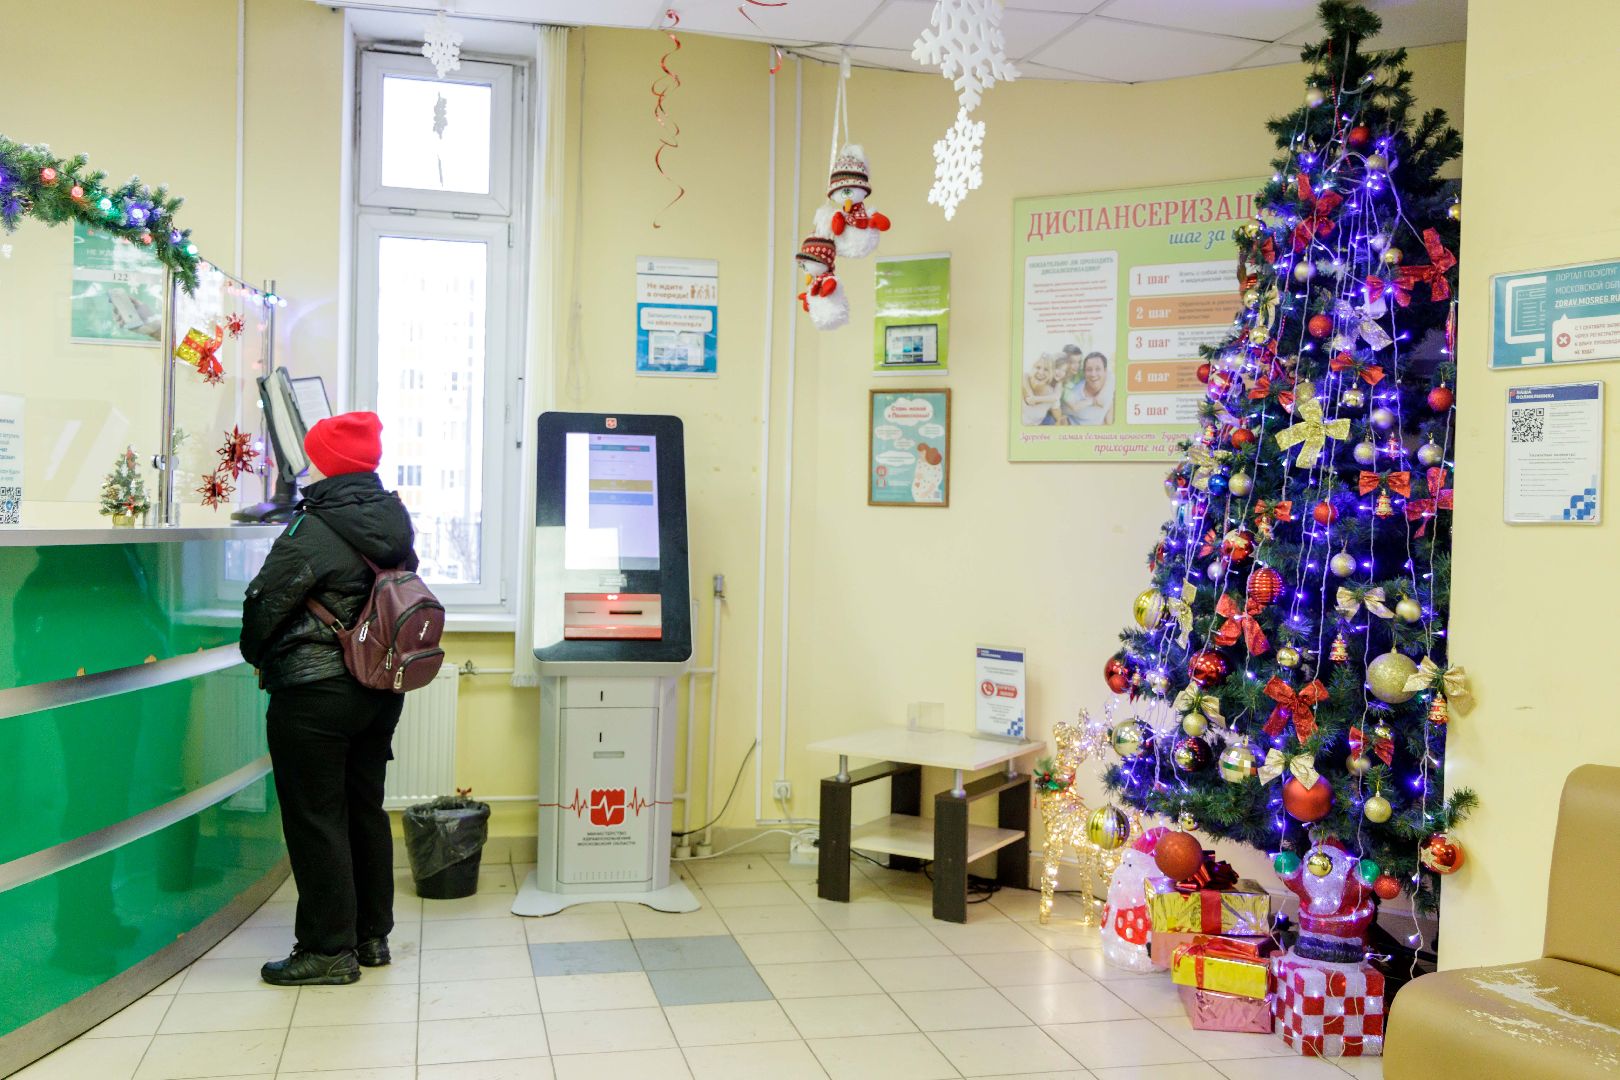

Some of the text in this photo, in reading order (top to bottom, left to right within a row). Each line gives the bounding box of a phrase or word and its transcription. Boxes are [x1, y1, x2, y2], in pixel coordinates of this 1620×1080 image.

[1027, 194, 1263, 242] ДИСПАНСЕРИЗАЦ
[1169, 231, 1202, 245] шаг
[1204, 229, 1226, 250] за
[113, 273, 128, 281] 122
[1136, 273, 1170, 285] 1 шаг
[1556, 267, 1617, 281] ПОРТАЛ ГОСУСЛУГ
[1555, 281, 1603, 295] МОСКОВСКОЙ
[1554, 294, 1620, 308] ZDRAV.MOSREG.RU
[1136, 307, 1171, 320] 2 шаг
[1136, 336, 1143, 348] 3
[1148, 338, 1170, 348] шаг
[1135, 369, 1143, 383] 4
[1147, 372, 1170, 382] шаг
[1134, 404, 1141, 416] 5
[1146, 406, 1169, 416] шаг
[1094, 443, 1147, 456] приходите
[1152, 444, 1165, 452] на
